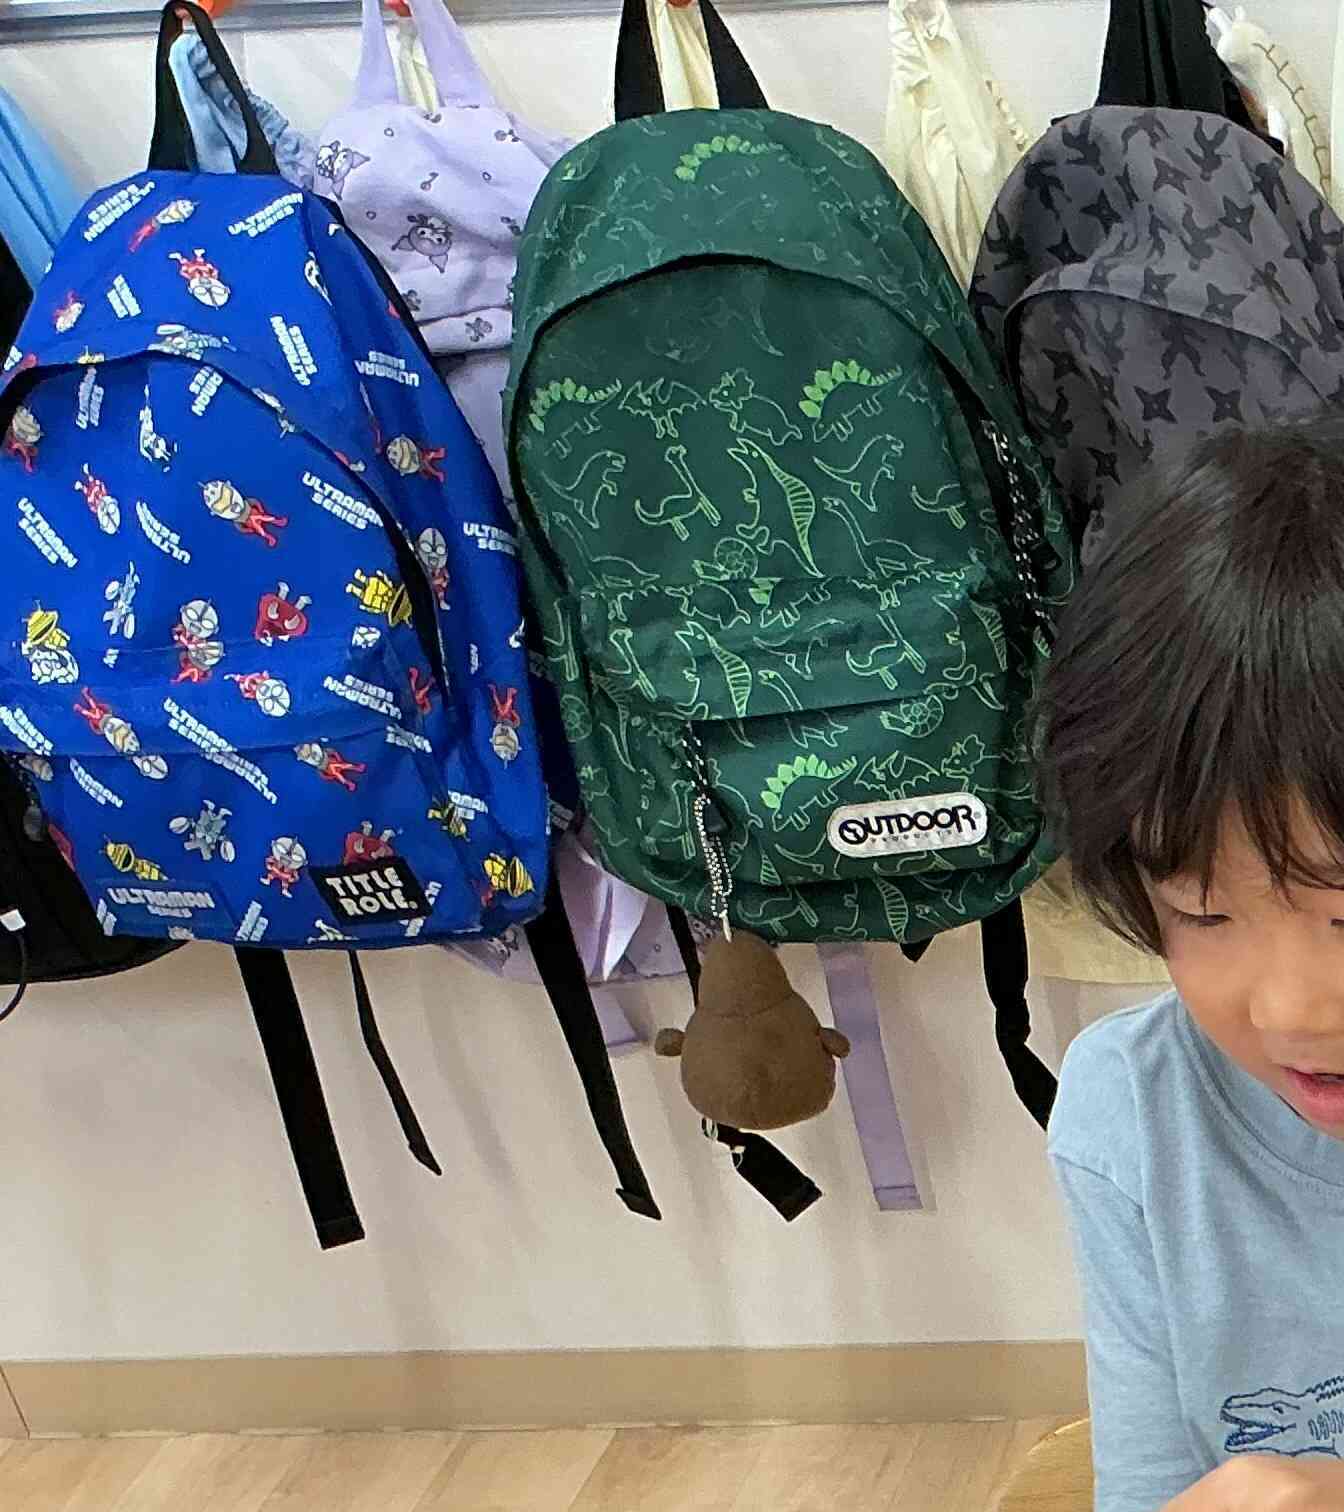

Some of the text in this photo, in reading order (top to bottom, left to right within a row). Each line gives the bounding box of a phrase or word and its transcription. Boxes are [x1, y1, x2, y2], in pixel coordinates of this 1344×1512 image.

[311, 492, 369, 531] SERIES
[18, 497, 79, 568] ULTRAMAN
[838, 804, 976, 845] OUTDOOR
[106, 887, 216, 909] ULTRAMAN
[326, 866, 402, 897] TITLE
